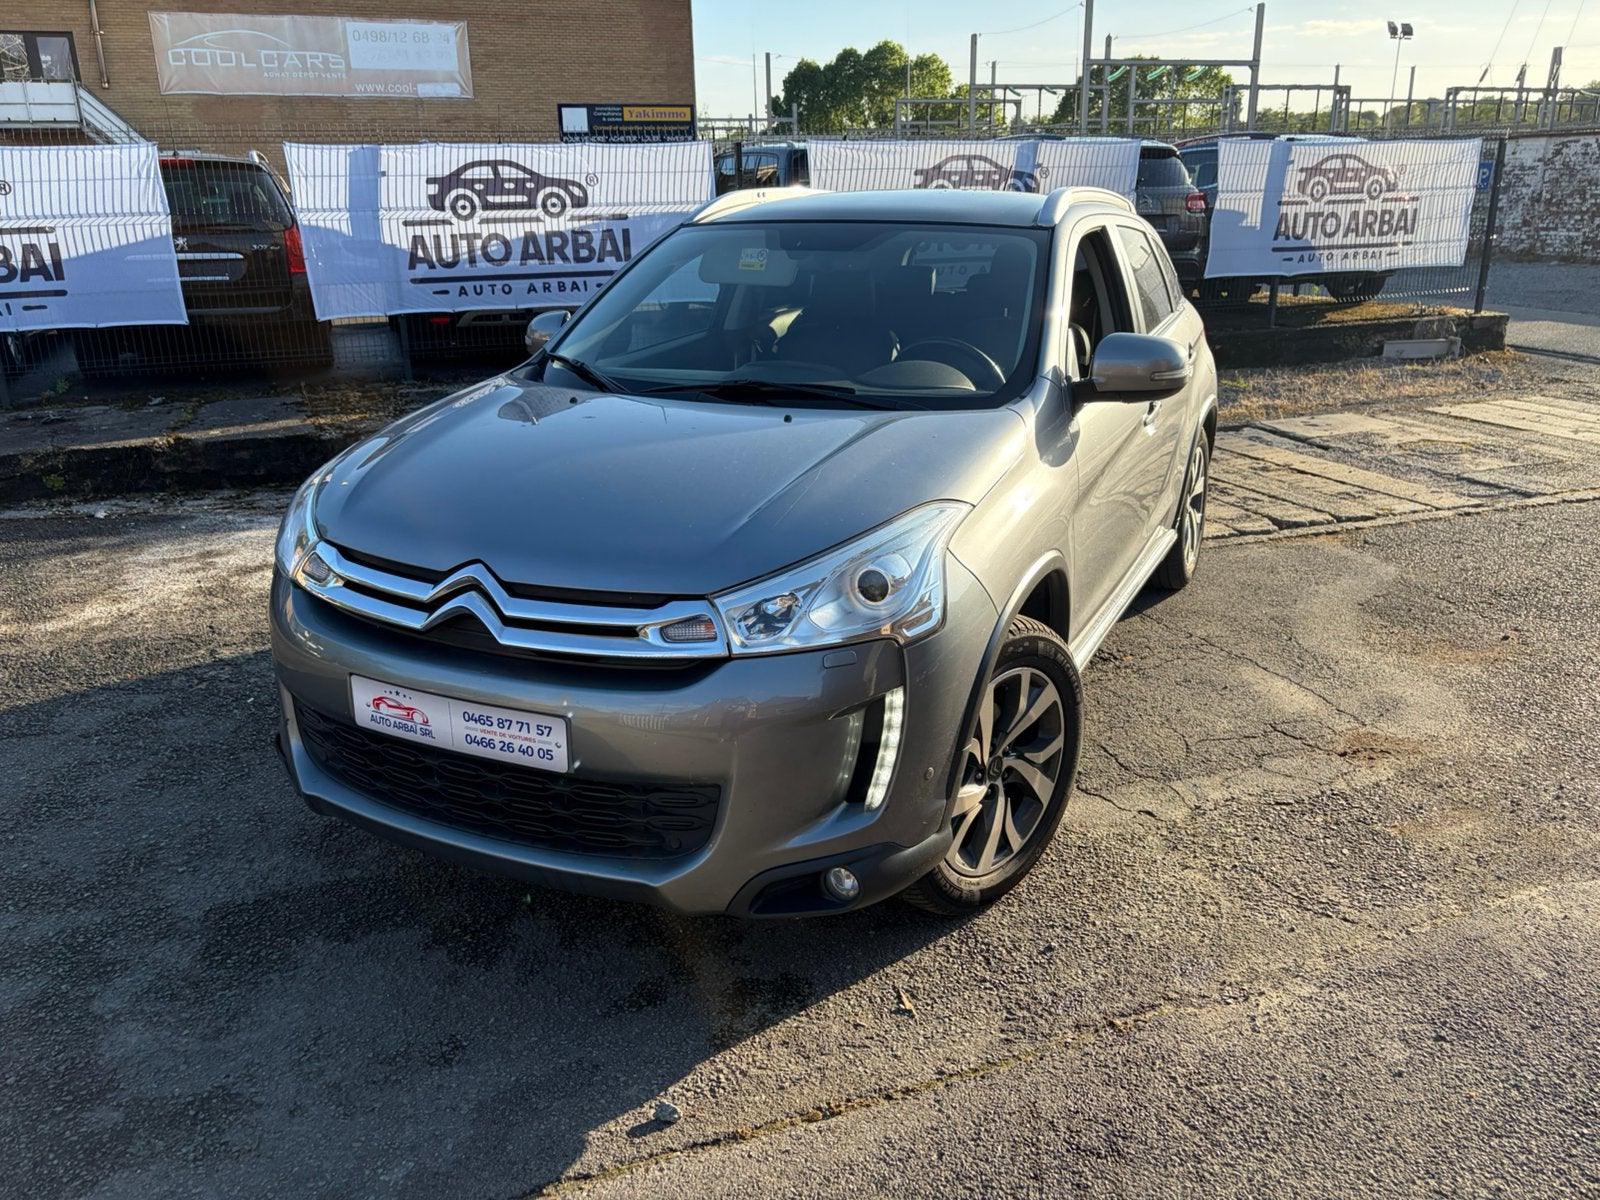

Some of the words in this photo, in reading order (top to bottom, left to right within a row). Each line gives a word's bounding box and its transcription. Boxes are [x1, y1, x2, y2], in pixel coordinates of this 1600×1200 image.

[627, 109, 687, 119] Yakimmo
[1273, 211, 1342, 241] AUTO
[1342, 207, 1418, 239] ARBAI
[408, 232, 513, 271] AUTO
[519, 227, 632, 267] ARBAI
[1297, 252, 1334, 264] AUTO
[1341, 250, 1383, 261] ARBAI
[458, 283, 513, 298] AUTO
[527, 280, 588, 295] ARBAI
[370, 714, 392, 728] AUTO
[419, 727, 436, 739] SRL
[462, 711, 494, 728] 0465
[497, 717, 513, 731] 87
[516, 720, 531, 734] 71
[536, 724, 553, 738] 57
[479, 728, 498, 737] VENTE
[498, 731, 507, 739] DE
[508, 733, 537, 744] VOITURES
[465, 733, 496, 750] 0466
[498, 740, 515, 754] 26
[518, 744, 534, 758] 40
[537, 747, 554, 761] 05
